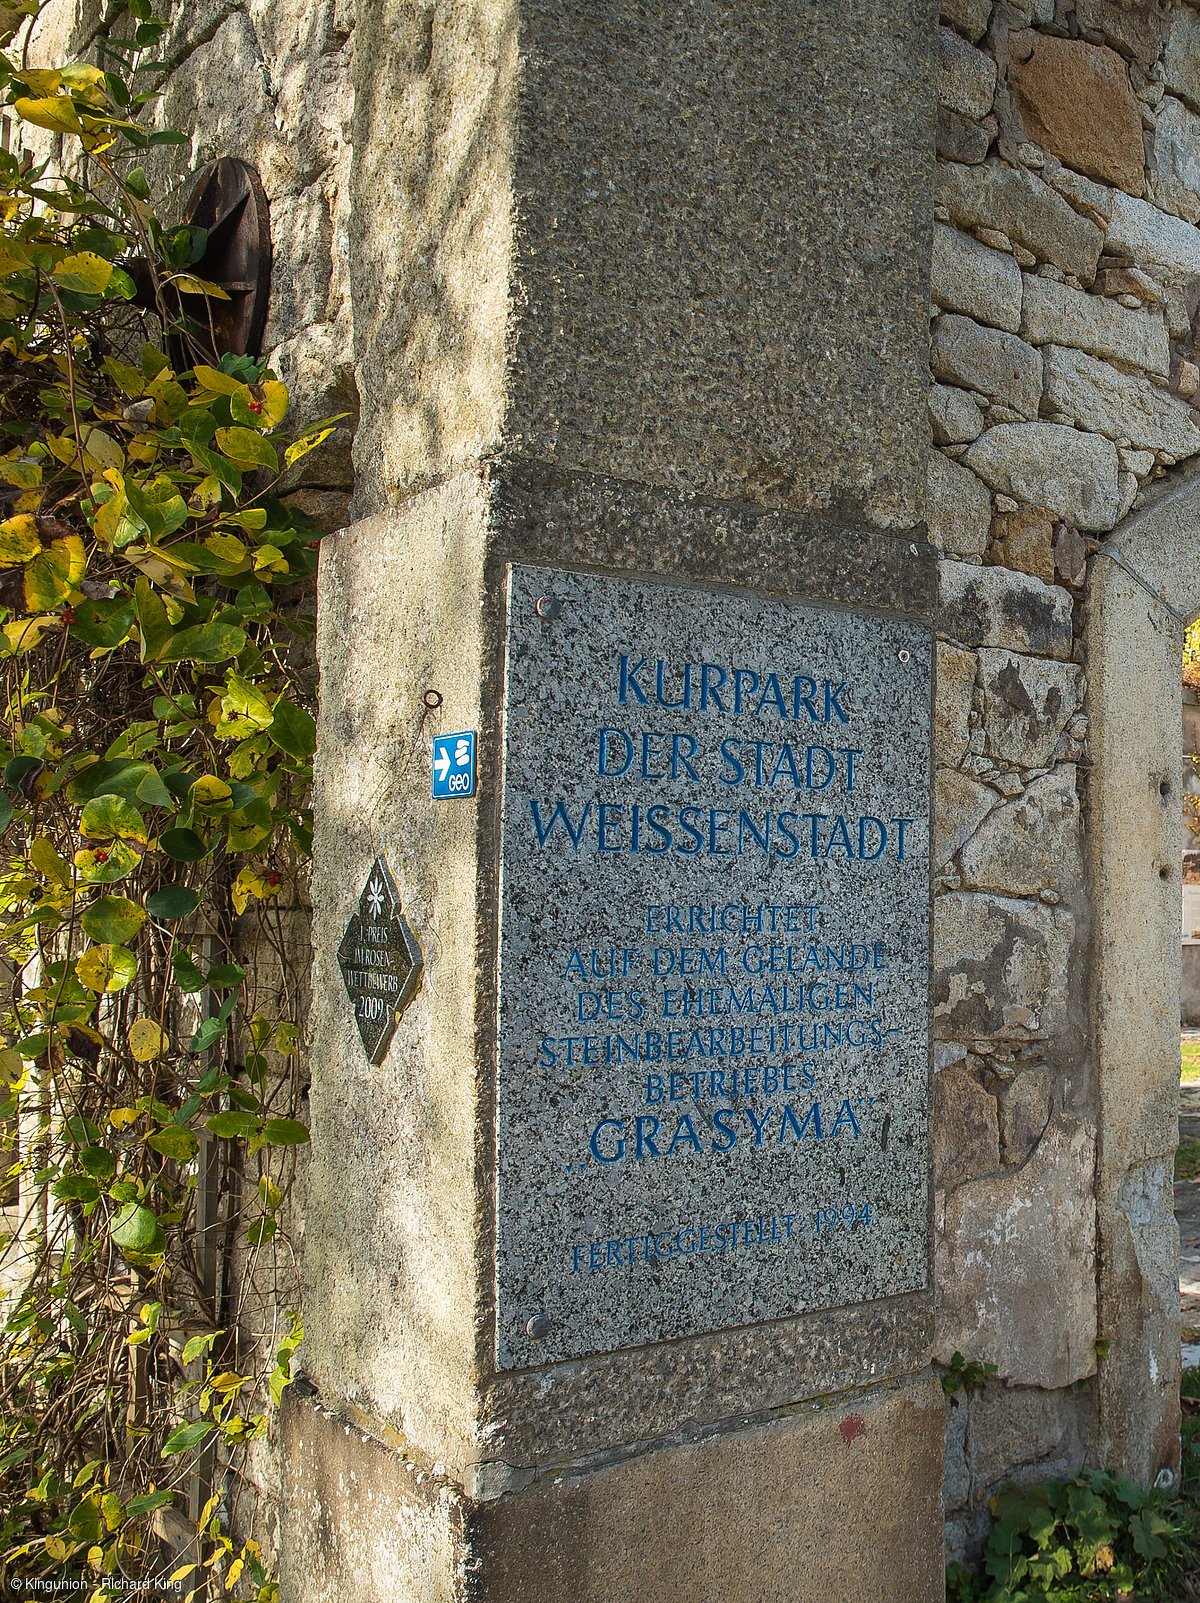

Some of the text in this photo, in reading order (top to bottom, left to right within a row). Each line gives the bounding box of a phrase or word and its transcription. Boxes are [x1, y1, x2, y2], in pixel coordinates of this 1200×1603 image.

[617, 654, 850, 725] KURPARK
[598, 727, 864, 792] DER STADT
[529, 800, 914, 862] WEISSENSTADT
[367, 926, 389, 944] PREIS
[646, 904, 820, 934] ERRICHTET
[365, 949, 395, 968] ROSEN-
[561, 941, 887, 981] AUF DEM GELÄNDE
[347, 969, 399, 993] WETTBEWERB
[358, 995, 384, 1021] 2009
[576, 981, 873, 1023] DES EHEMALIGEN
[539, 1018, 901, 1070] STEINBEARBEITUNGS-
[645, 1062, 816, 1104] BETRIEBES
[815, 1202, 873, 1234] 1994
